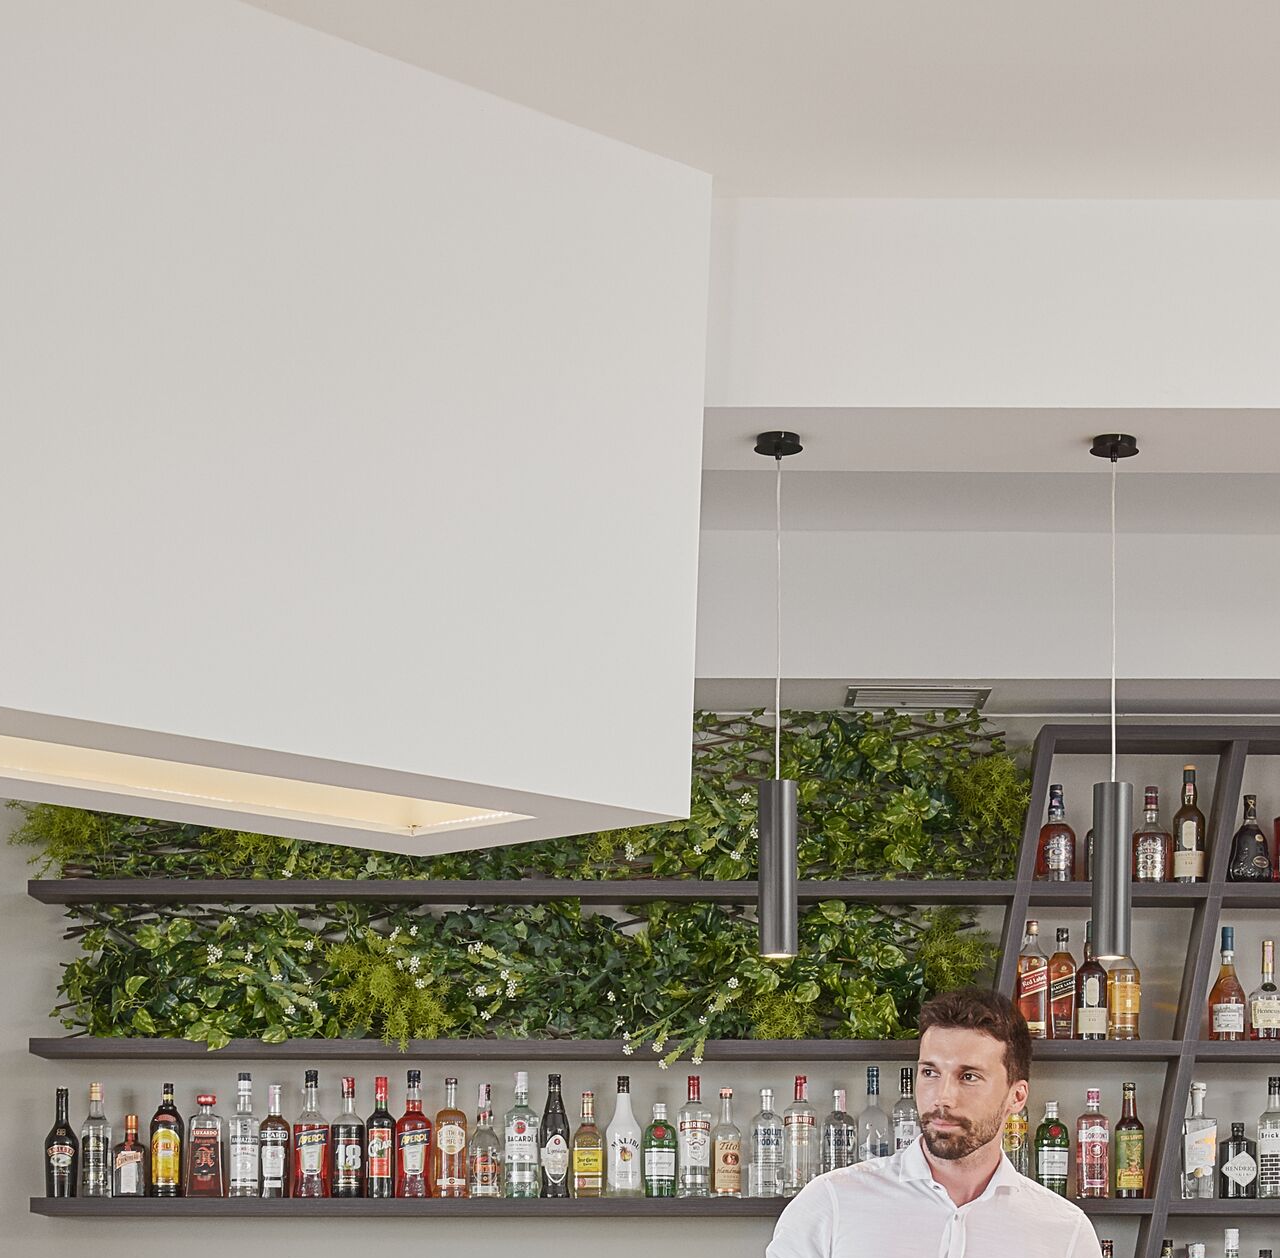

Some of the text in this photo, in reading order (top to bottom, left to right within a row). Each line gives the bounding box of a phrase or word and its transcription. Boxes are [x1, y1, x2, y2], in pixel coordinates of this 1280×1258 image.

[1021, 974, 1047, 987] Red Label
[1005, 1122, 1028, 1130] ORDON'S
[298, 1133, 326, 1146] APEROL
[400, 1133, 428, 1146] APEROL
[611, 1138, 640, 1150] MALIBU
[336, 1144, 361, 1170] 18
